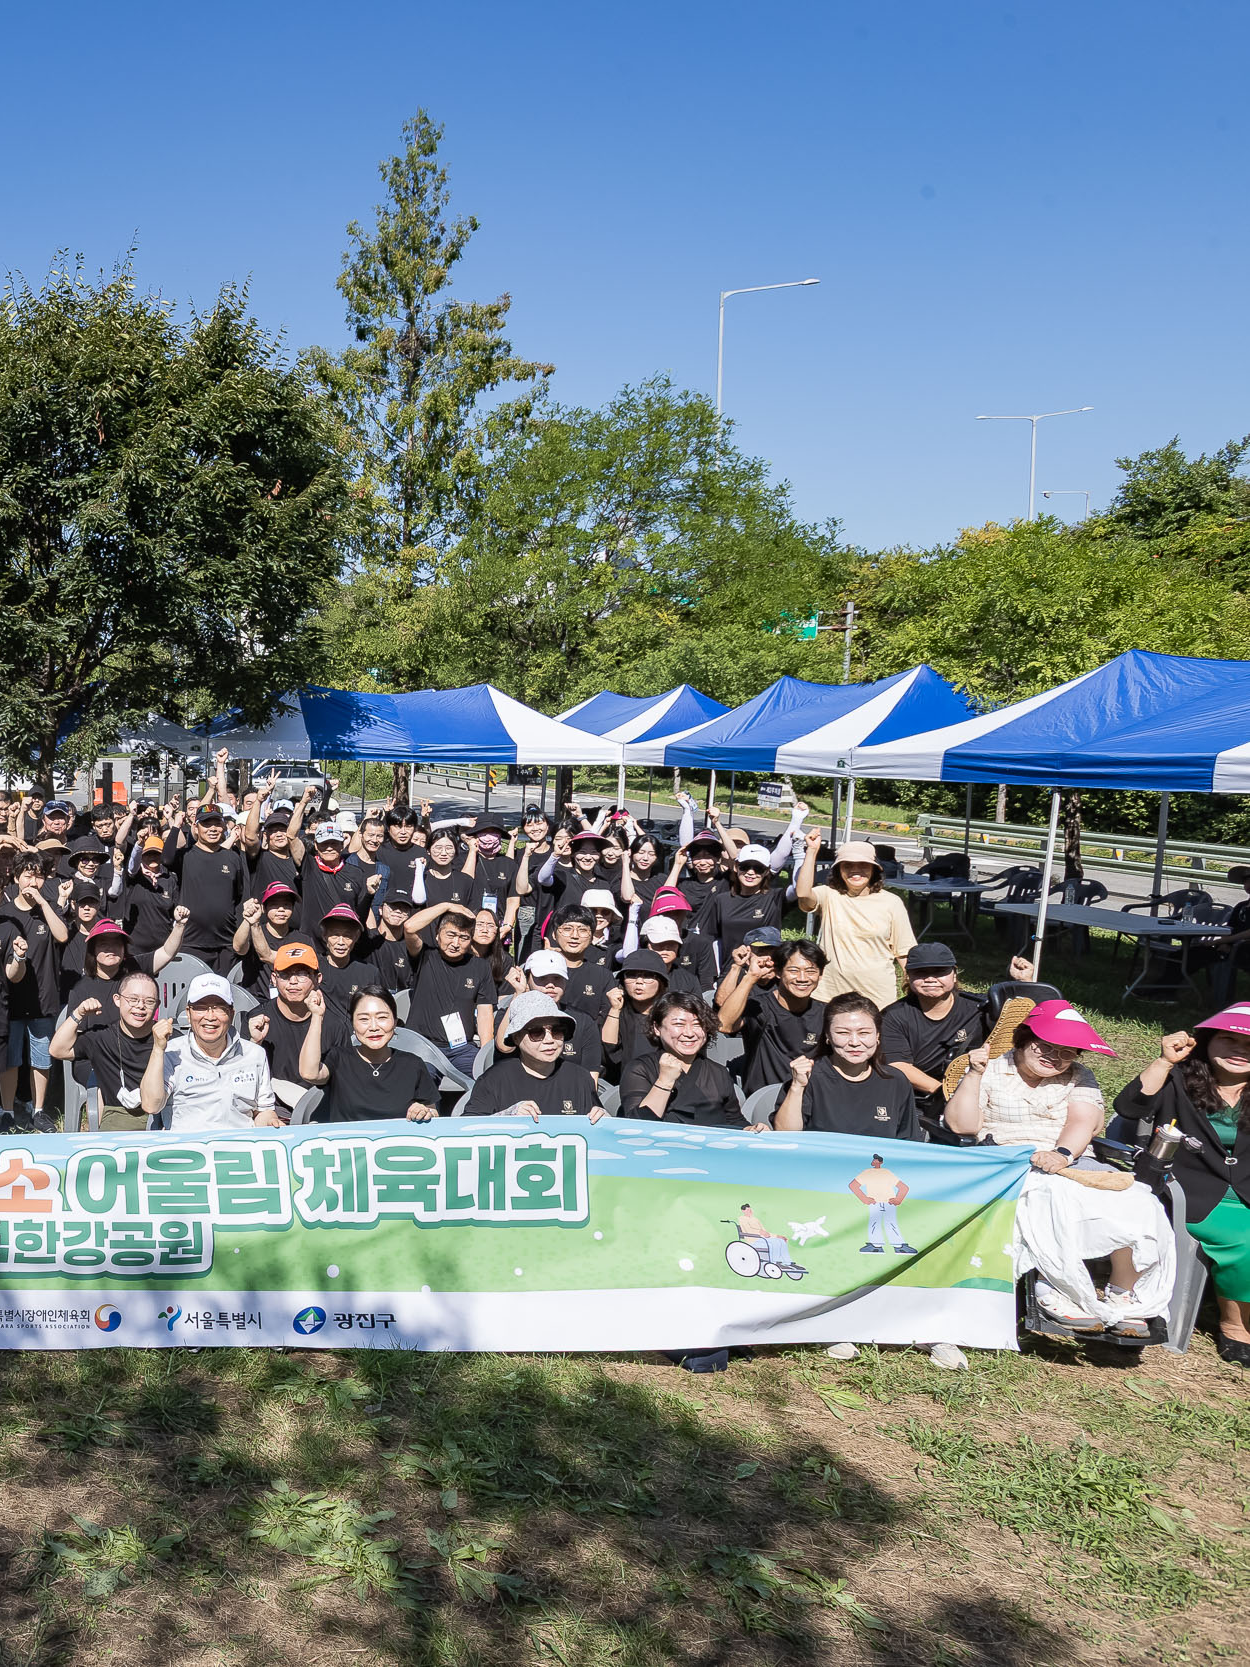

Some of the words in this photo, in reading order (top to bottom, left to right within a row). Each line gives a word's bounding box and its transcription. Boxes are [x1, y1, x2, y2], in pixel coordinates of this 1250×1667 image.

[75, 1149, 283, 1215] 어울림
[301, 1143, 579, 1213] 체육대회
[183, 1310, 263, 1331] 서울특별시
[332, 1312, 398, 1330] 광진구
